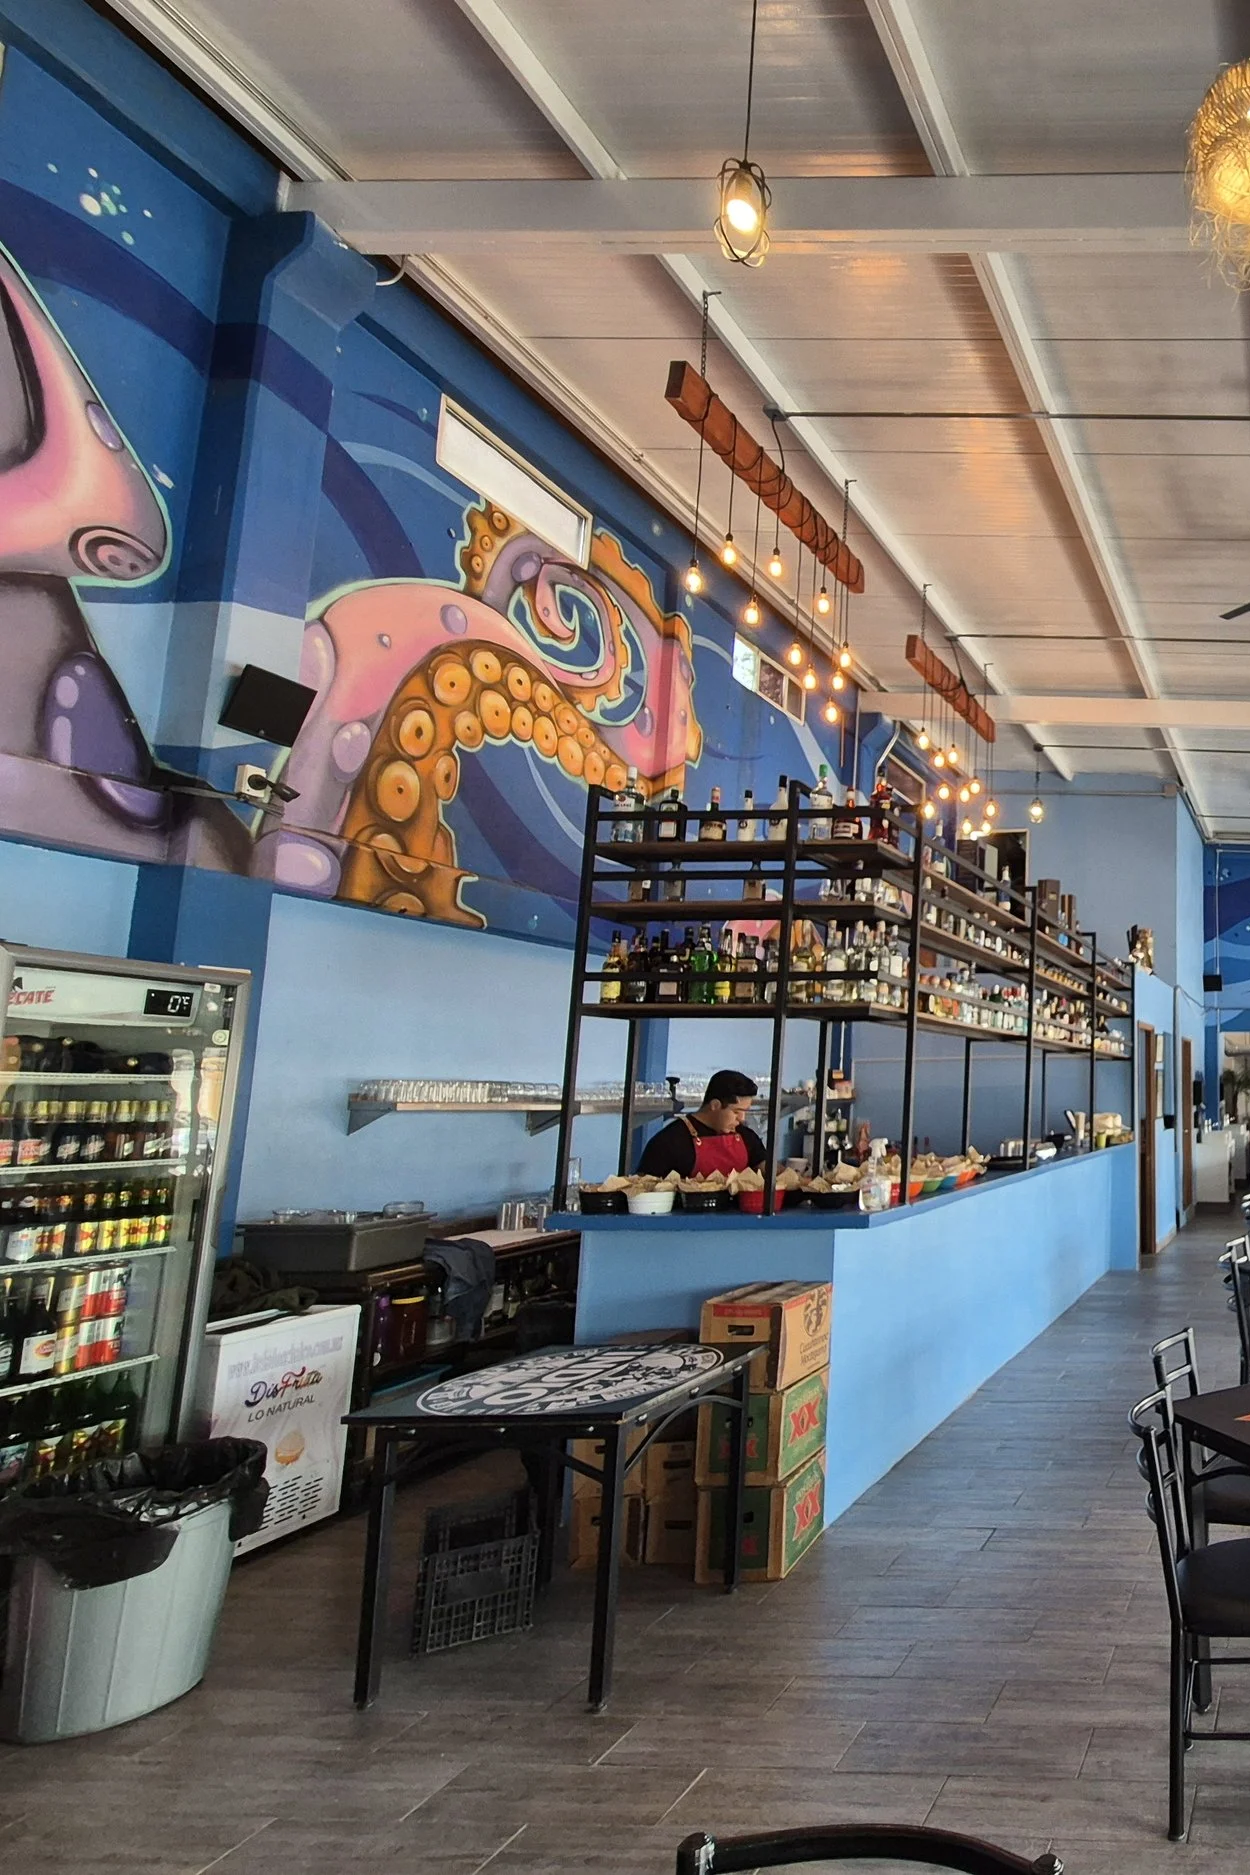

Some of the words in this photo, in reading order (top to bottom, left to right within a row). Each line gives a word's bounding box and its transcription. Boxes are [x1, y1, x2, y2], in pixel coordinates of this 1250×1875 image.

[8, 989, 55, 1006] ECATE
[247, 1411, 266, 1423] LO
[266, 1394, 317, 1418] NATURAL
